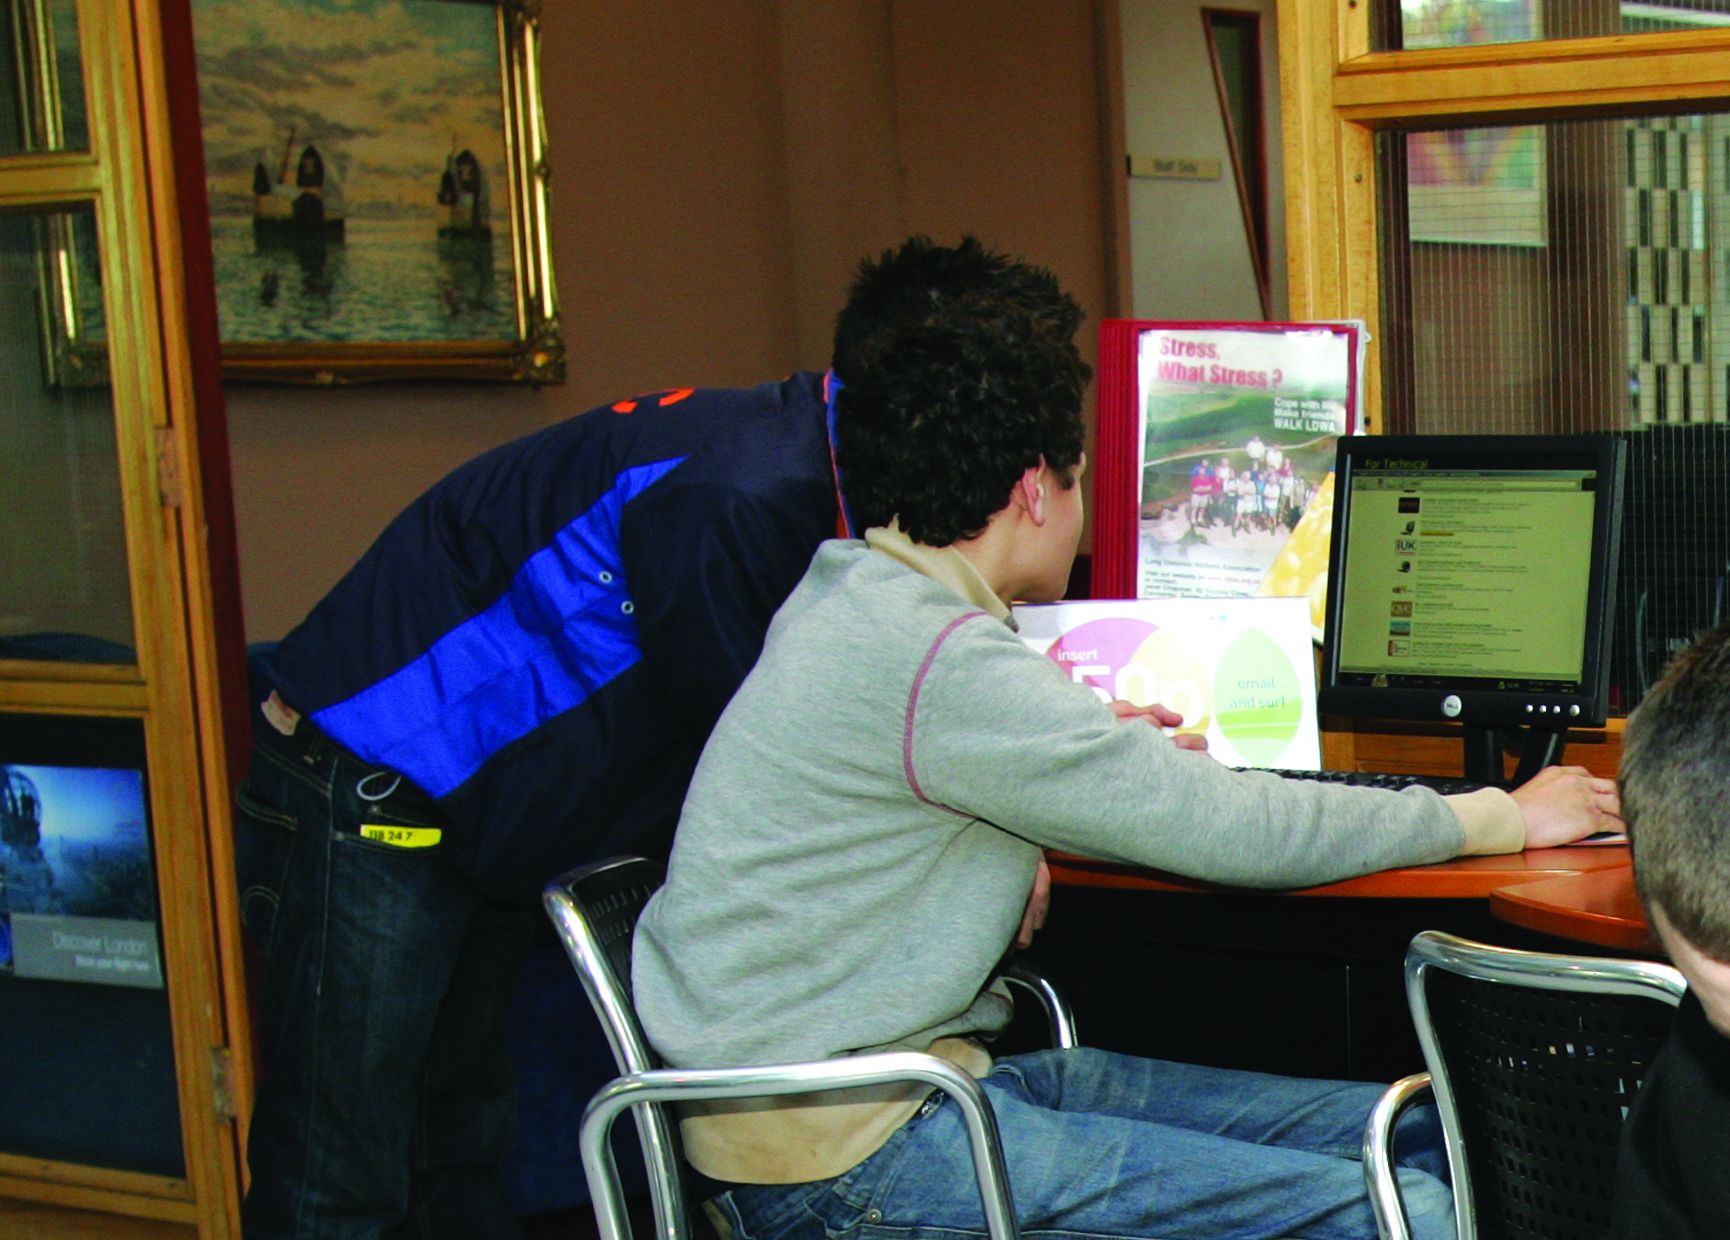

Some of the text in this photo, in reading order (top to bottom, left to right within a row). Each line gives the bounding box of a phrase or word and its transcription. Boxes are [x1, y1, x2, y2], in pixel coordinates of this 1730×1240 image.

[1159, 336, 1221, 361] Stress,
[1158, 361, 1284, 388] What Stress ?
[1274, 417, 1336, 432] WALK LDWA
[1057, 648, 1098, 661] insert
[1238, 677, 1276, 690] email
[1230, 695, 1255, 709] and
